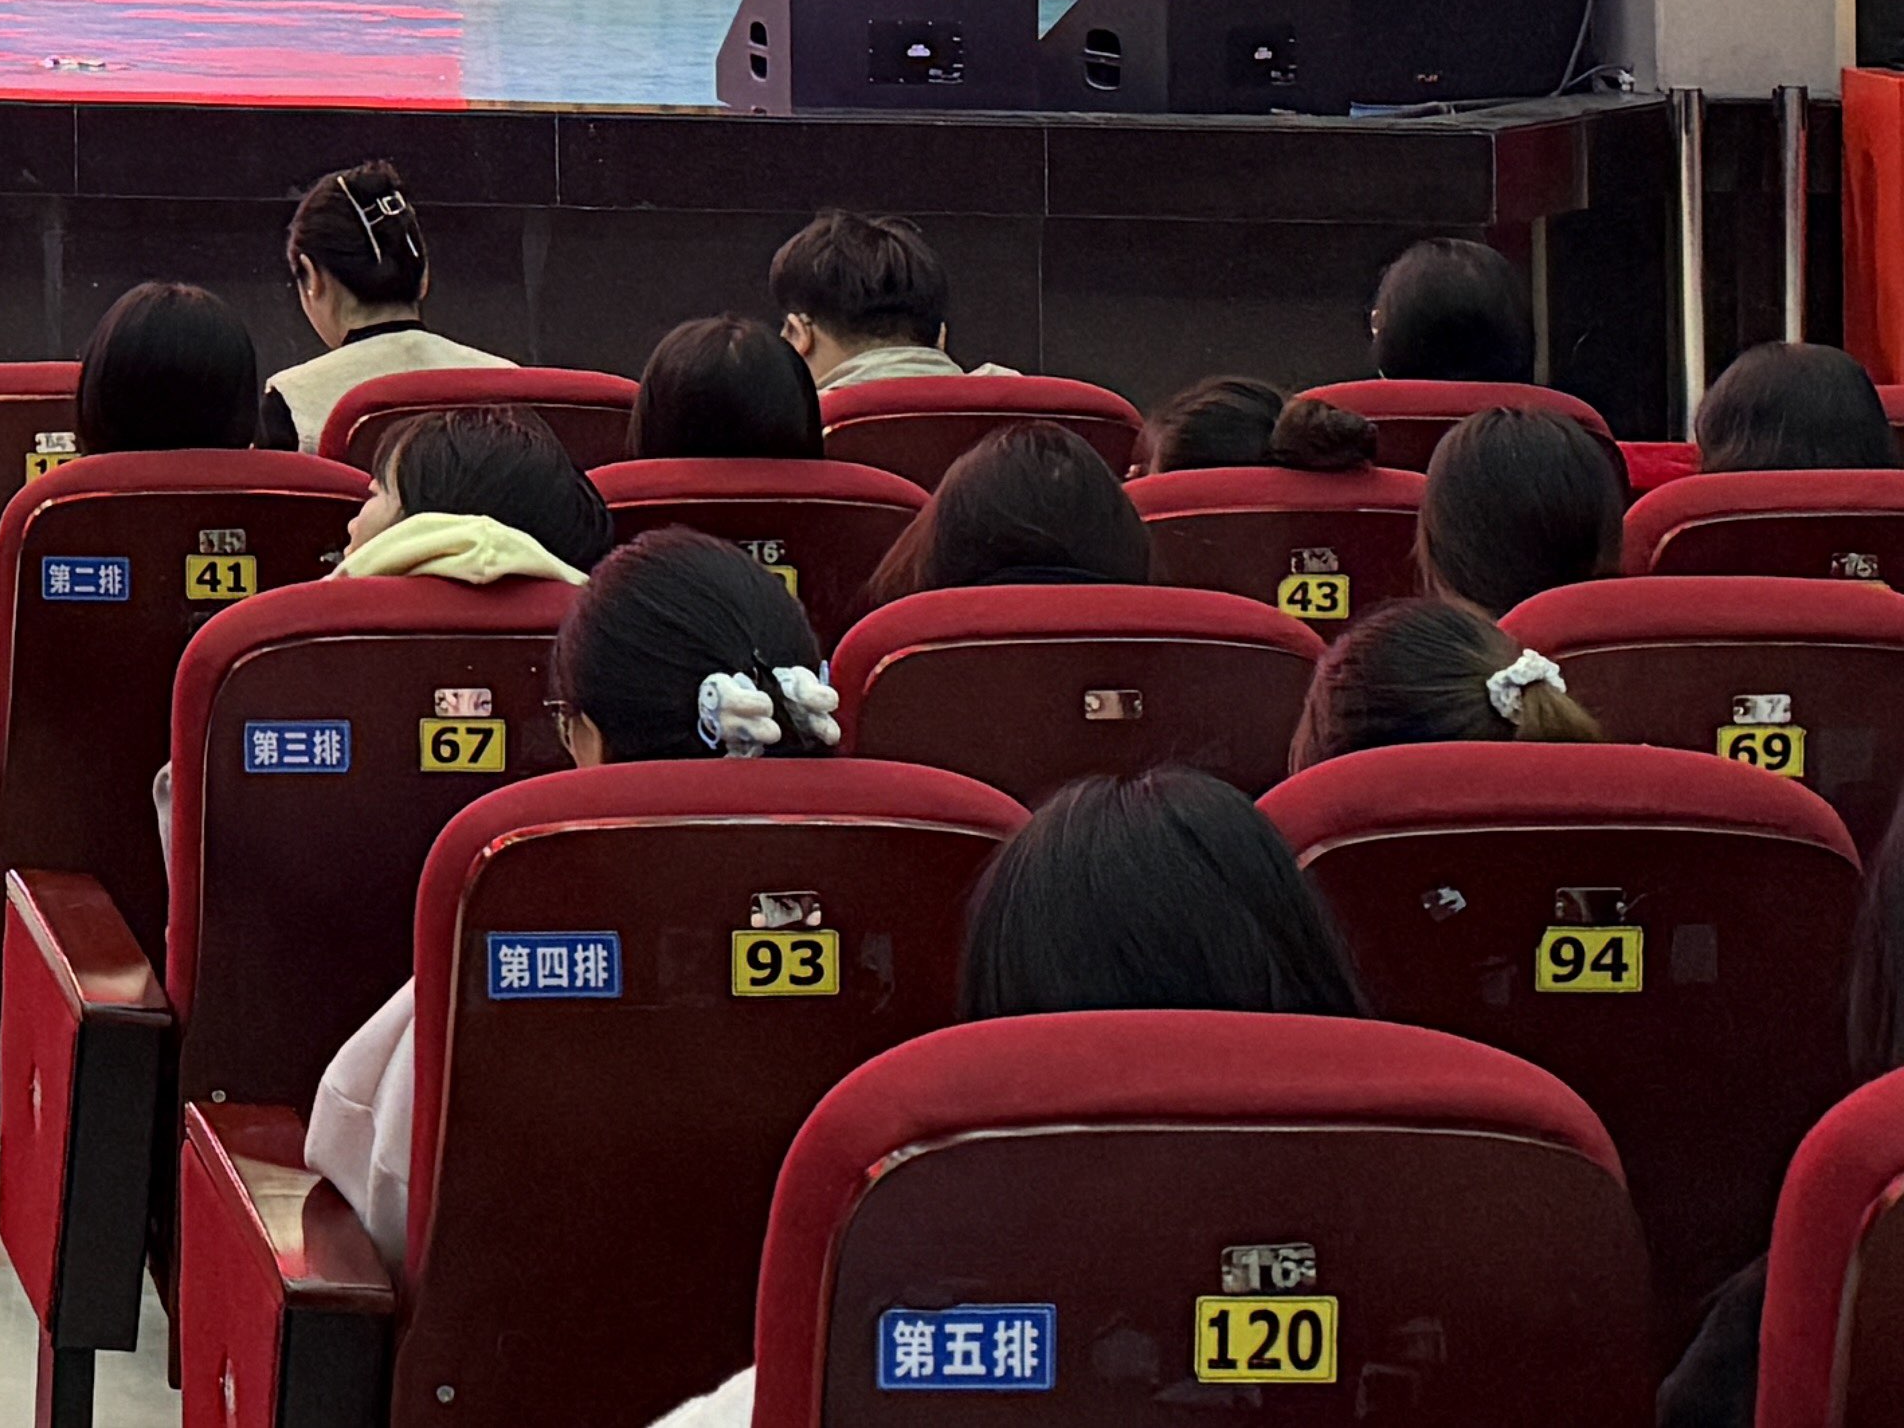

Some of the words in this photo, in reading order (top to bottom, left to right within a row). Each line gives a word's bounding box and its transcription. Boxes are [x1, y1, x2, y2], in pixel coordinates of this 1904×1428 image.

[48, 563, 123, 595] 第二排
[195, 561, 249, 593] 41
[1286, 581, 1340, 613] 43
[252, 729, 342, 766] 第三排
[431, 726, 495, 765] 67
[1729, 732, 1793, 771] 69
[498, 943, 609, 989] 第四排
[745, 939, 825, 987] 93
[1548, 934, 1630, 984] 94
[892, 1318, 1040, 1379] 第五排
[1206, 1308, 1324, 1372] 120
